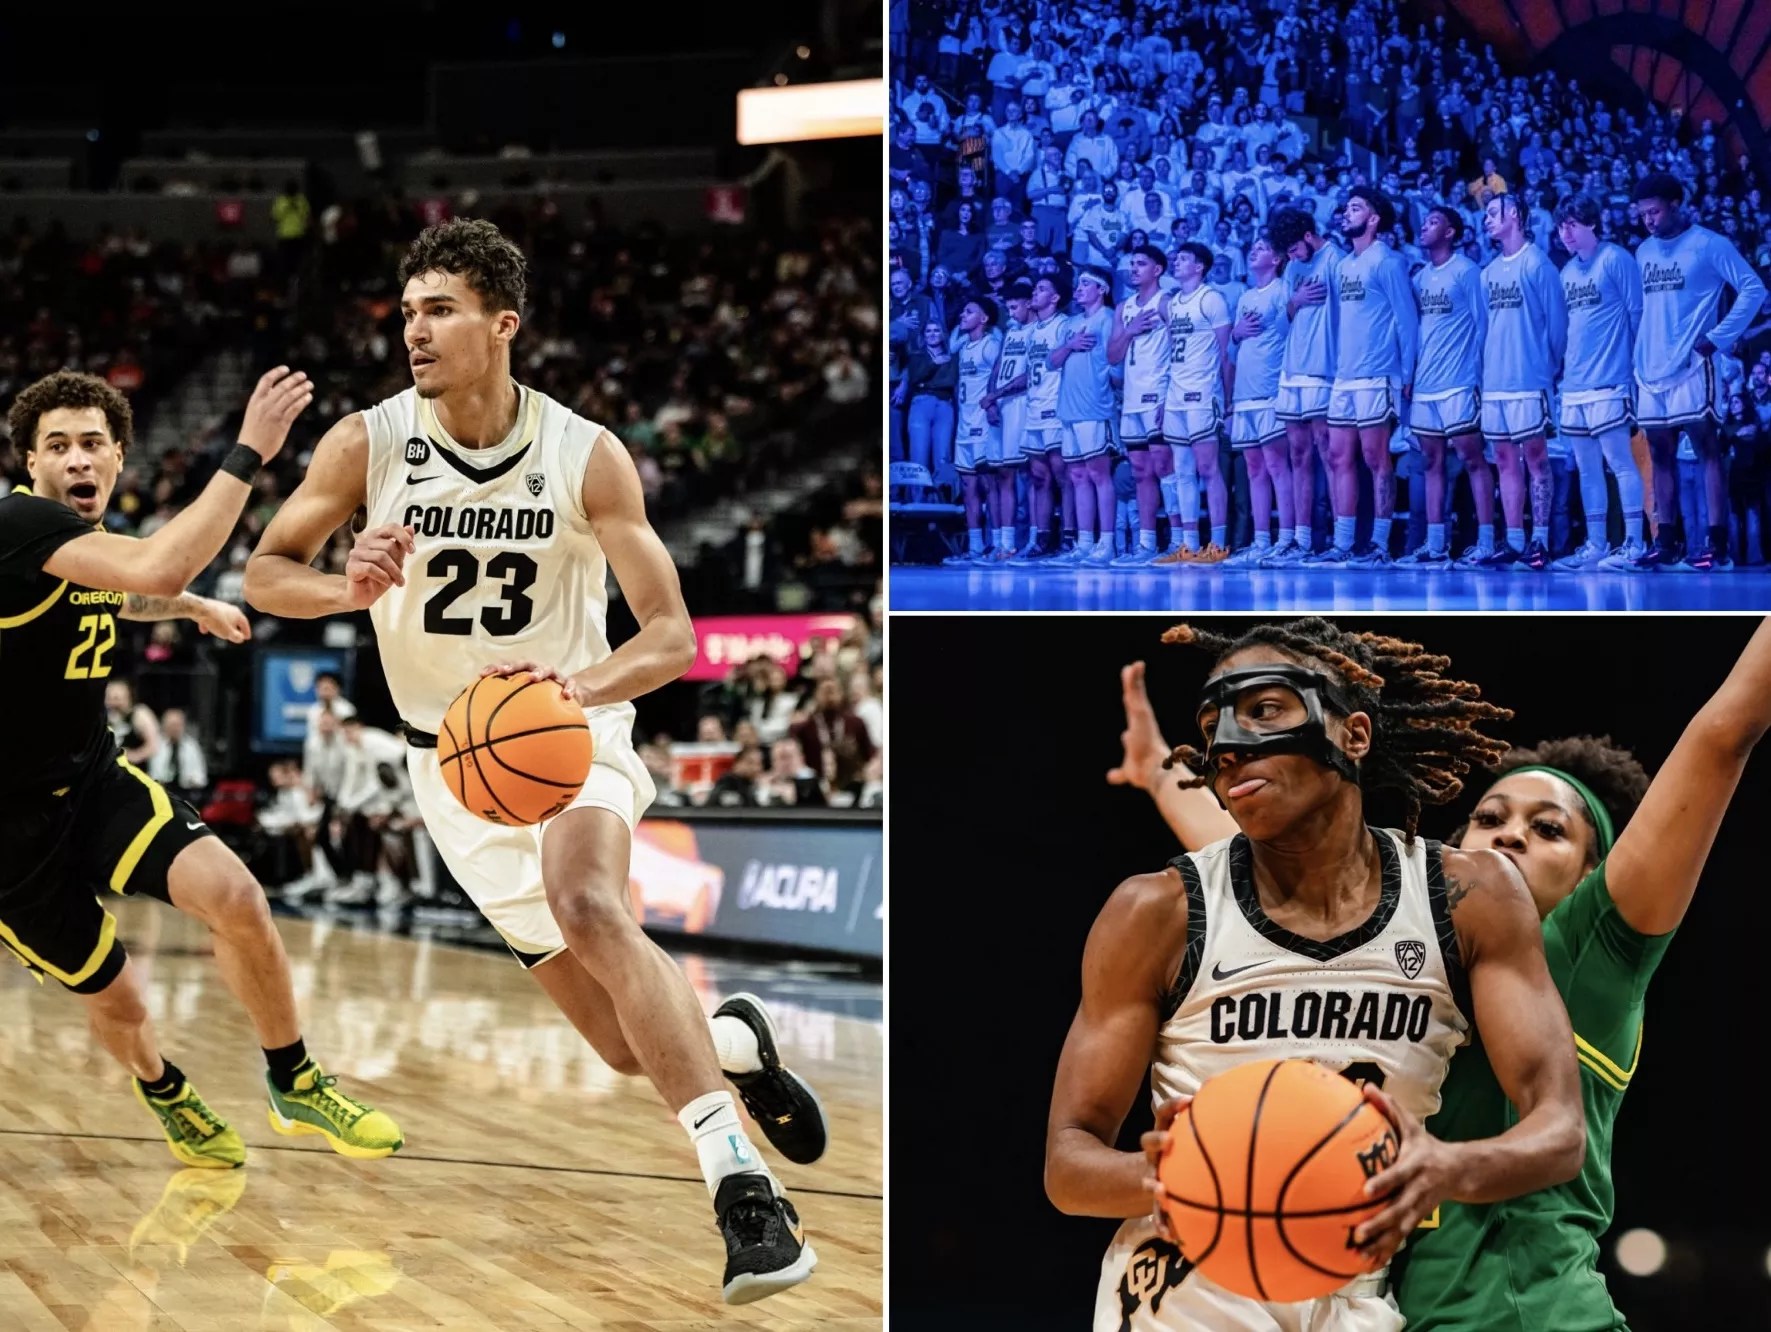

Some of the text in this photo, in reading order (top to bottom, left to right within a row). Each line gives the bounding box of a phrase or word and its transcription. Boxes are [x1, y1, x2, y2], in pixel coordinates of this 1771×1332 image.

[1000, 360, 1016, 381] 10
[406, 443, 426, 460] BH
[531, 483, 541, 493] 12
[404, 504, 555, 541] COLORADO
[424, 548, 538, 637] 23
[64, 613, 116, 680] 22
[754, 862, 839, 912] ACURA
[1404, 957, 1418, 971] 12
[1210, 991, 1432, 1044] COLORADO
[1126, 1248, 1169, 1302] CU
